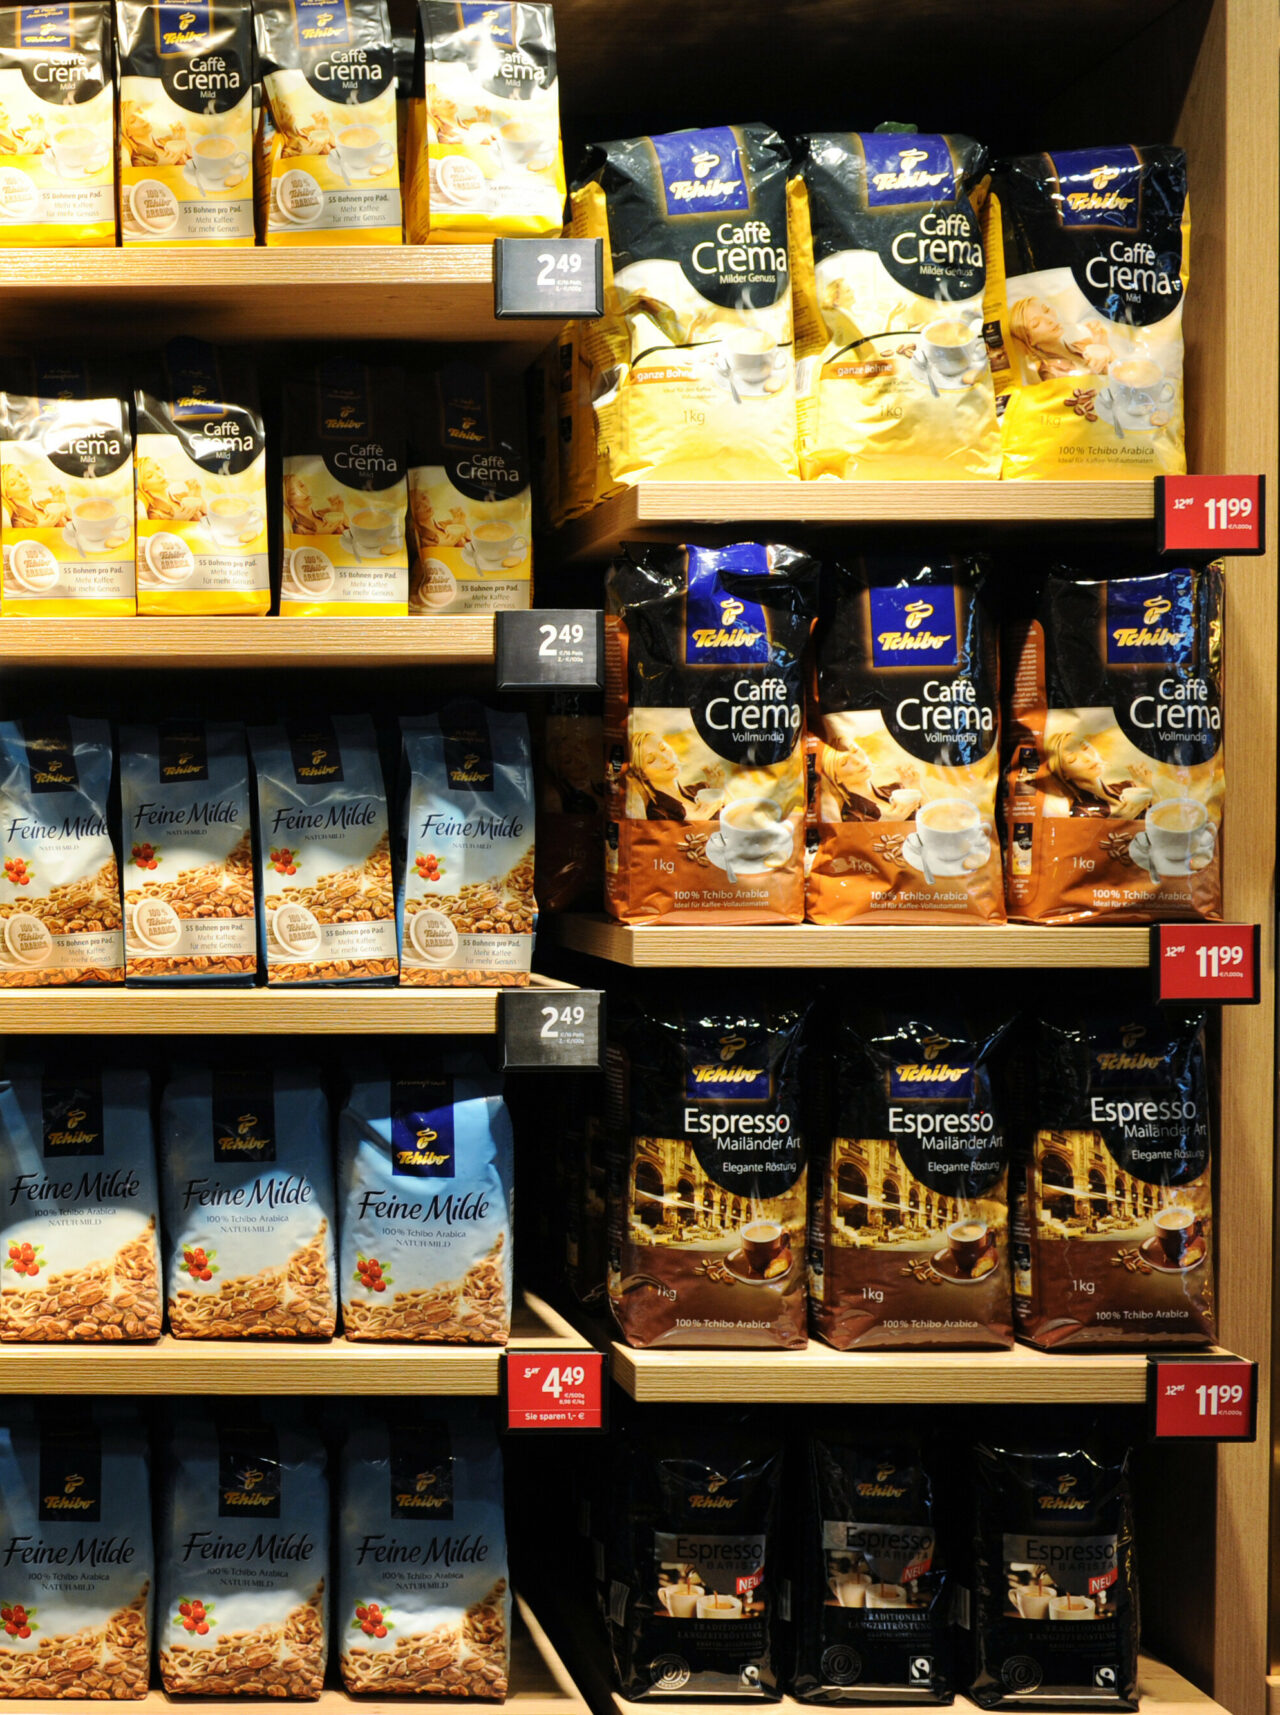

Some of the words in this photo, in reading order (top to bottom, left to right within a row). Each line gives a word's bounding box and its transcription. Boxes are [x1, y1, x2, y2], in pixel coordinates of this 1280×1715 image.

[163, 32, 207, 45] Tchibo
[189, 56, 226, 72] Caffè
[331, 50, 367, 63] Caffè
[173, 69, 240, 90] Crema
[315, 62, 382, 82] Crema
[670, 180, 741, 201] Tchibo
[194, 205, 216, 213] Bohnen
[1067, 193, 1135, 211] Tchibo
[717, 222, 771, 245] Caffè
[920, 214, 970, 237] Caffè
[692, 242, 787, 275] Crema
[892, 232, 983, 267] Crema
[1110, 241, 1156, 265] Caffè
[720, 274, 746, 284] Milder
[748, 273, 776, 284] Genuss
[1086, 256, 1173, 295] Crema
[349, 444, 383, 456] Caffè
[334, 453, 398, 472] Crema
[692, 629, 763, 648] Tchibo
[734, 680, 787, 701] Caffè
[1159, 678, 1208, 701] Caffè
[705, 698, 800, 730] Crema
[1130, 696, 1220, 730] Crema
[732, 731, 785, 744] Vollmundig
[1158, 730, 1208, 744] Vollmundig
[134, 803, 186, 829] Feine
[186, 800, 238, 826] Milde
[421, 814, 472, 839] Feine
[473, 814, 523, 840] Milde
[652, 859, 675, 875] 1kg
[692, 1065, 763, 1083] Tchibo
[1091, 1097, 1196, 1127] Espresso
[684, 1108, 790, 1139] Espresso
[1124, 1124, 1191, 1138] Mailänder
[1194, 1124, 1207, 1136] Art
[717, 1136, 783, 1150] Mailänder
[786, 1136, 801, 1149] Art
[722, 1162, 764, 1174] Elegante
[766, 1161, 797, 1173] Röstung
[10, 1173, 72, 1206] Feine
[74, 1169, 139, 1201] Milde
[183, 1178, 244, 1210] Feine
[246, 1176, 311, 1209] Milde
[359, 1190, 420, 1220] Feine
[422, 1192, 489, 1224] Milde
[861, 1287, 884, 1302] 1kg
[525, 1413, 538, 1421] Sie
[539, 1414, 566, 1423] sparen
[1038, 1497, 1090, 1511] Tchibo
[4, 1536, 69, 1568] Feine
[68, 1537, 135, 1567] Milde
[356, 1535, 420, 1566] Feine
[422, 1534, 488, 1567] Milde
[1026, 1540, 1115, 1563] Espresso
[1091, 1577, 1113, 1593] NEU
